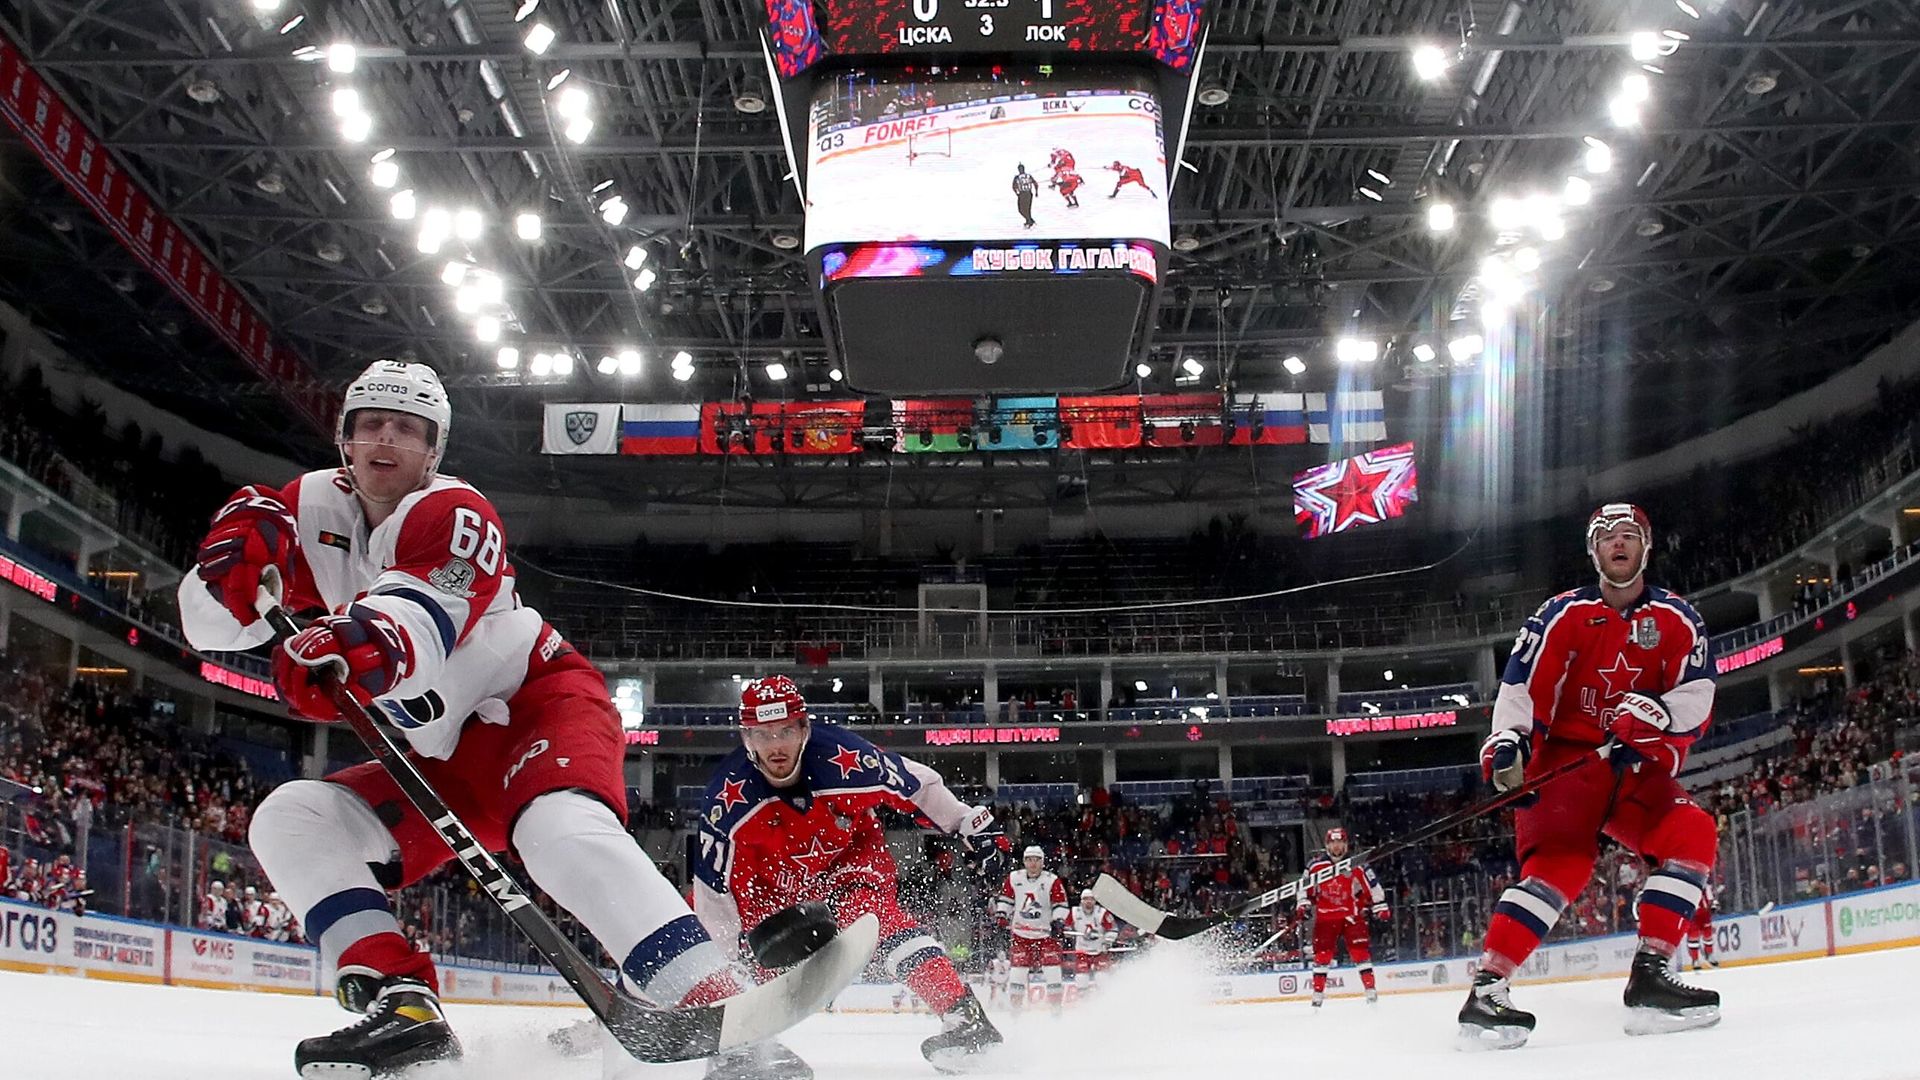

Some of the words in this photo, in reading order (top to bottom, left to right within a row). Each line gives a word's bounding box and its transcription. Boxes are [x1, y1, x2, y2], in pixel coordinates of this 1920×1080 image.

[900, 27, 952, 46] ЦСКА
[980, 14, 994, 36] 3
[1025, 25, 1066, 41] ЛОК
[973, 248, 1054, 271] КУБОК
[367, 382, 409, 395] согаз
[450, 507, 501, 577] 68
[1510, 626, 1541, 664] 37
[432, 810, 532, 913] CCM
[700, 830, 725, 873] 71
[1261, 858, 1352, 908] BAUER
[0, 910, 57, 953] газ
